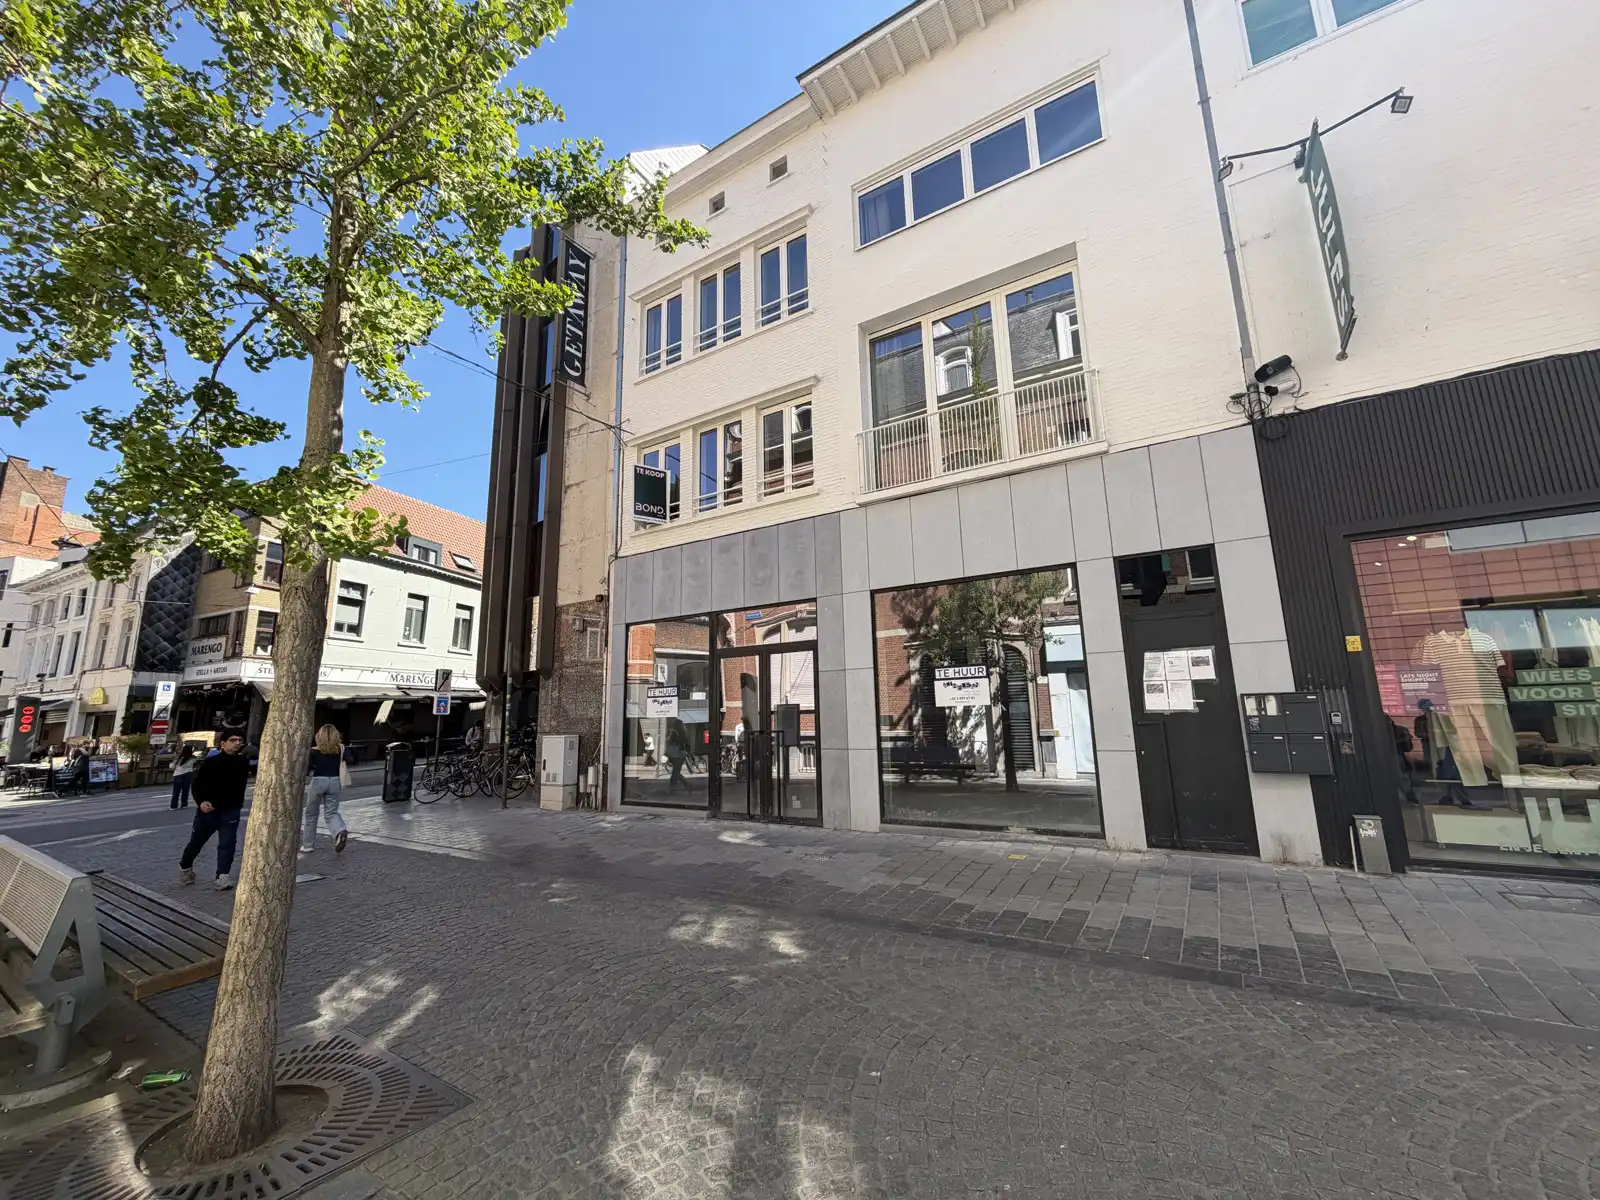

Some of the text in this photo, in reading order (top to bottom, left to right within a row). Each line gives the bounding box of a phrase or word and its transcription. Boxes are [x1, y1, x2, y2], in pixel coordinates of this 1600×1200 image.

[1311, 168, 1349, 328] JULES
[563, 248, 587, 377] GETAWAY
[636, 467, 665, 479] TE KOOP
[190, 642, 222, 656] MARENGO
[195, 666, 228, 676] STELLA ARTOIS
[936, 666, 985, 678] TE HUUR
[1521, 668, 1592, 683] WEES
[658, 688, 677, 696] HUUR
[1512, 686, 1584, 700] VOOR
